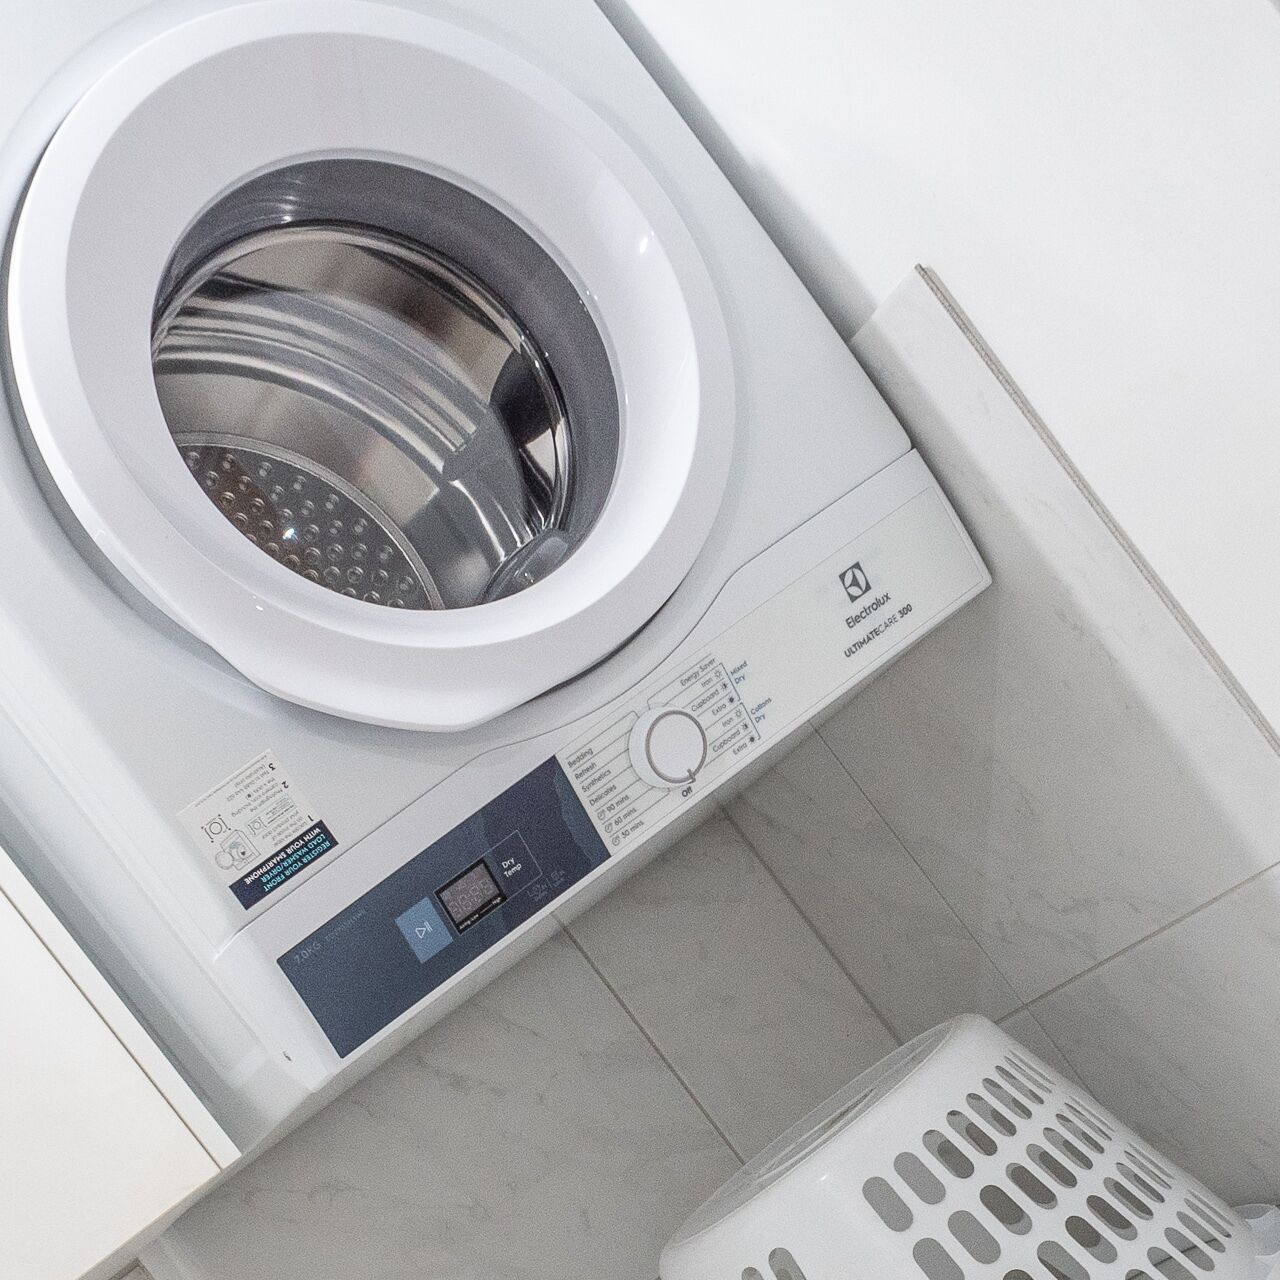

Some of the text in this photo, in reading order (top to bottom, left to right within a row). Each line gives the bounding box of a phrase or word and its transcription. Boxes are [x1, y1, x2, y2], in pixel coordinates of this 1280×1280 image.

[844, 590, 891, 629] Electrolux
[843, 603, 913, 658] ULTIMATECARE 300
[680, 656, 716, 687] Energy Saver
[733, 673, 746, 684] Dry
[700, 676, 713, 687] Iron
[690, 688, 720, 712] Cupboard
[711, 702, 727, 715] Extra
[749, 696, 772, 715] Cottons
[721, 716, 734, 727] Iron
[754, 712, 766, 723] Dry
[712, 729, 741, 752] Cupboard
[732, 742, 747, 755] Extra
[567, 747, 593, 768] Bedding
[267, 762, 275, 771] 3
[574, 761, 596, 780] Refresh
[281, 780, 289, 789] 2
[581, 768, 611, 793] Synthetics
[589, 783, 617, 806] Delicates
[680, 785, 693, 798] Off
[614, 794, 629, 807] mins
[307, 814, 313, 822] 1
[613, 806, 636, 825] 60 mins
[629, 819, 644, 832] mins
[243, 826, 320, 885] WITH YOUR SMARTPHONE
[260, 833, 325, 883] LOAD WASHER/DRYER
[501, 856, 515, 869] Dry
[262, 839, 330, 891] REGISTER YOUR FRONT
[504, 862, 522, 878] Temp
